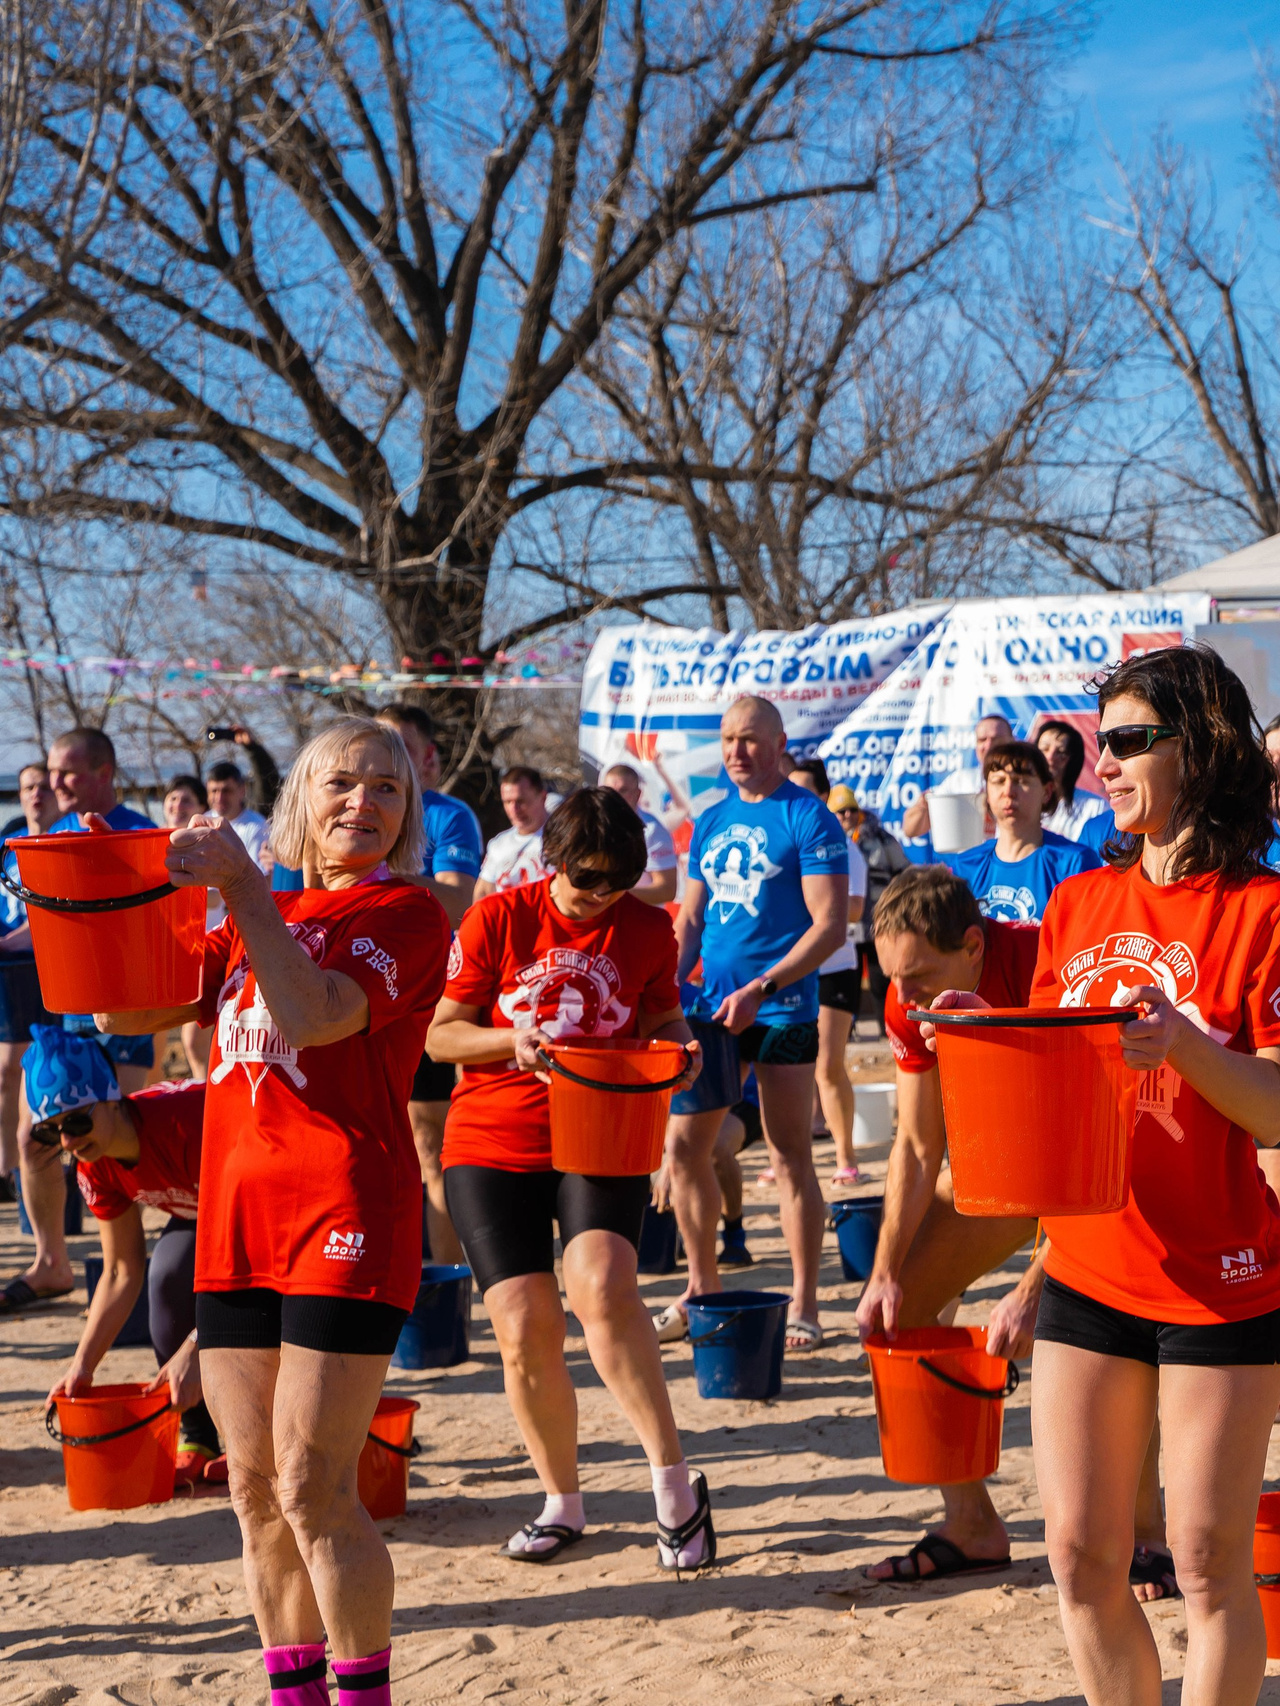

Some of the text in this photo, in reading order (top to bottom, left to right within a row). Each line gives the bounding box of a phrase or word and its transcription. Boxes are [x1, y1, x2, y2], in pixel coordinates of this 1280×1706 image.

[1110, 608, 1183, 627] АКЦИЯ
[1113, 936, 1155, 962] СЛАВА
[374, 947, 398, 980] ПУТЬ
[1067, 951, 1095, 981] СИЛА
[365, 955, 399, 1001] ДОМОЙ
[323, 1244, 366, 1257] SPORT
[1220, 1263, 1262, 1280] SPORT
